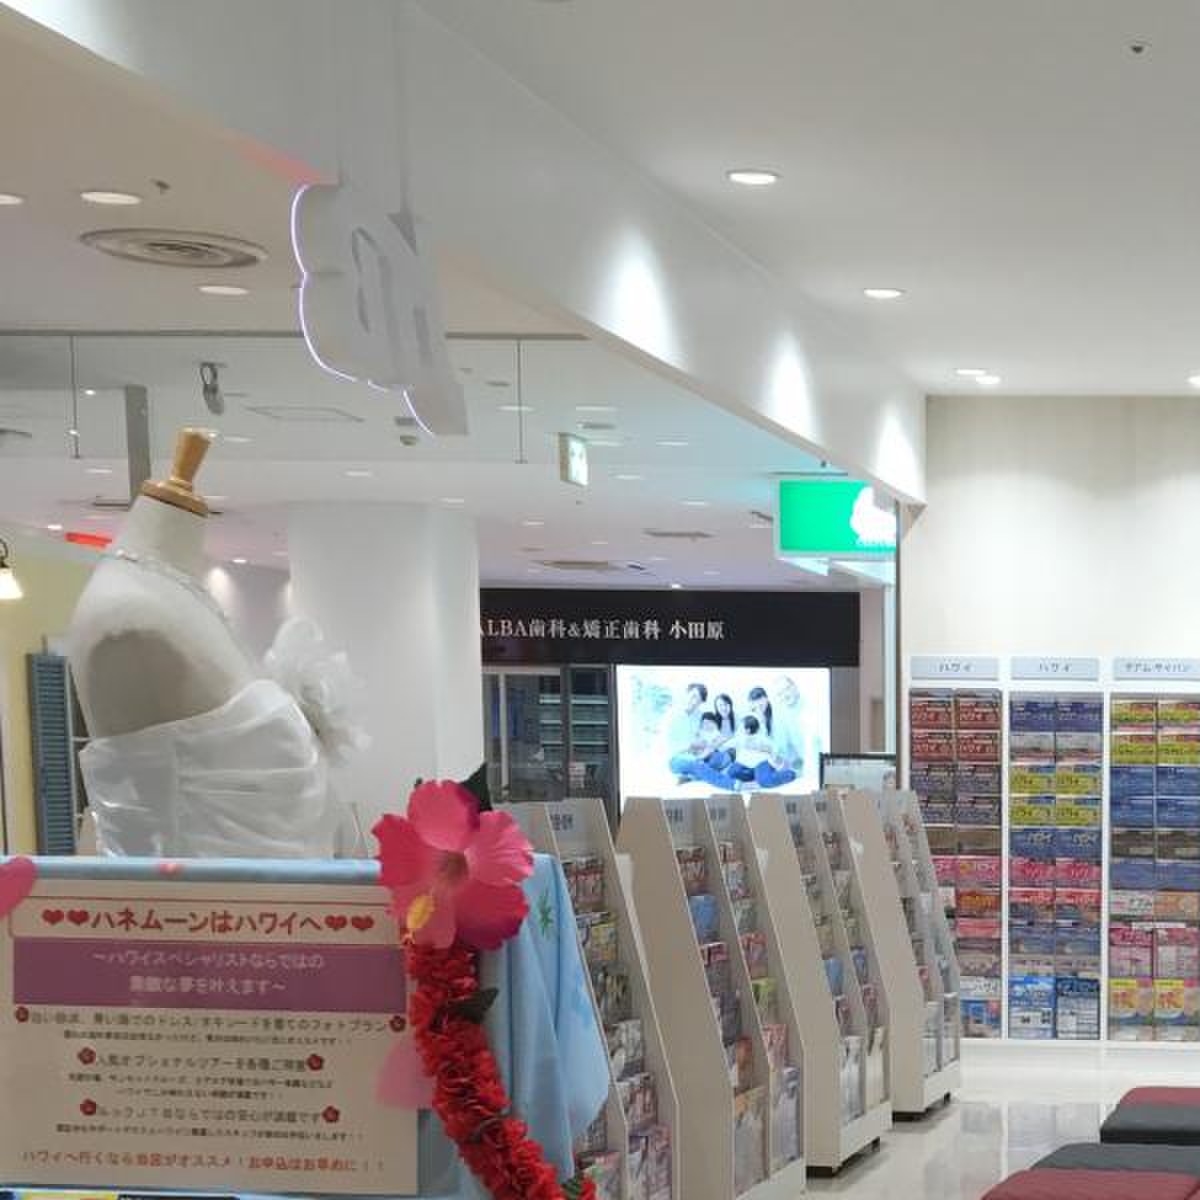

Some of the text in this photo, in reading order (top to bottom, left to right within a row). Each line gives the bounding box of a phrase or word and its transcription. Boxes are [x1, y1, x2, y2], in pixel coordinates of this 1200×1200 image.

[669, 619, 726, 641] 小田原
[90, 908, 322, 935] ハネムーンはハワイへ
